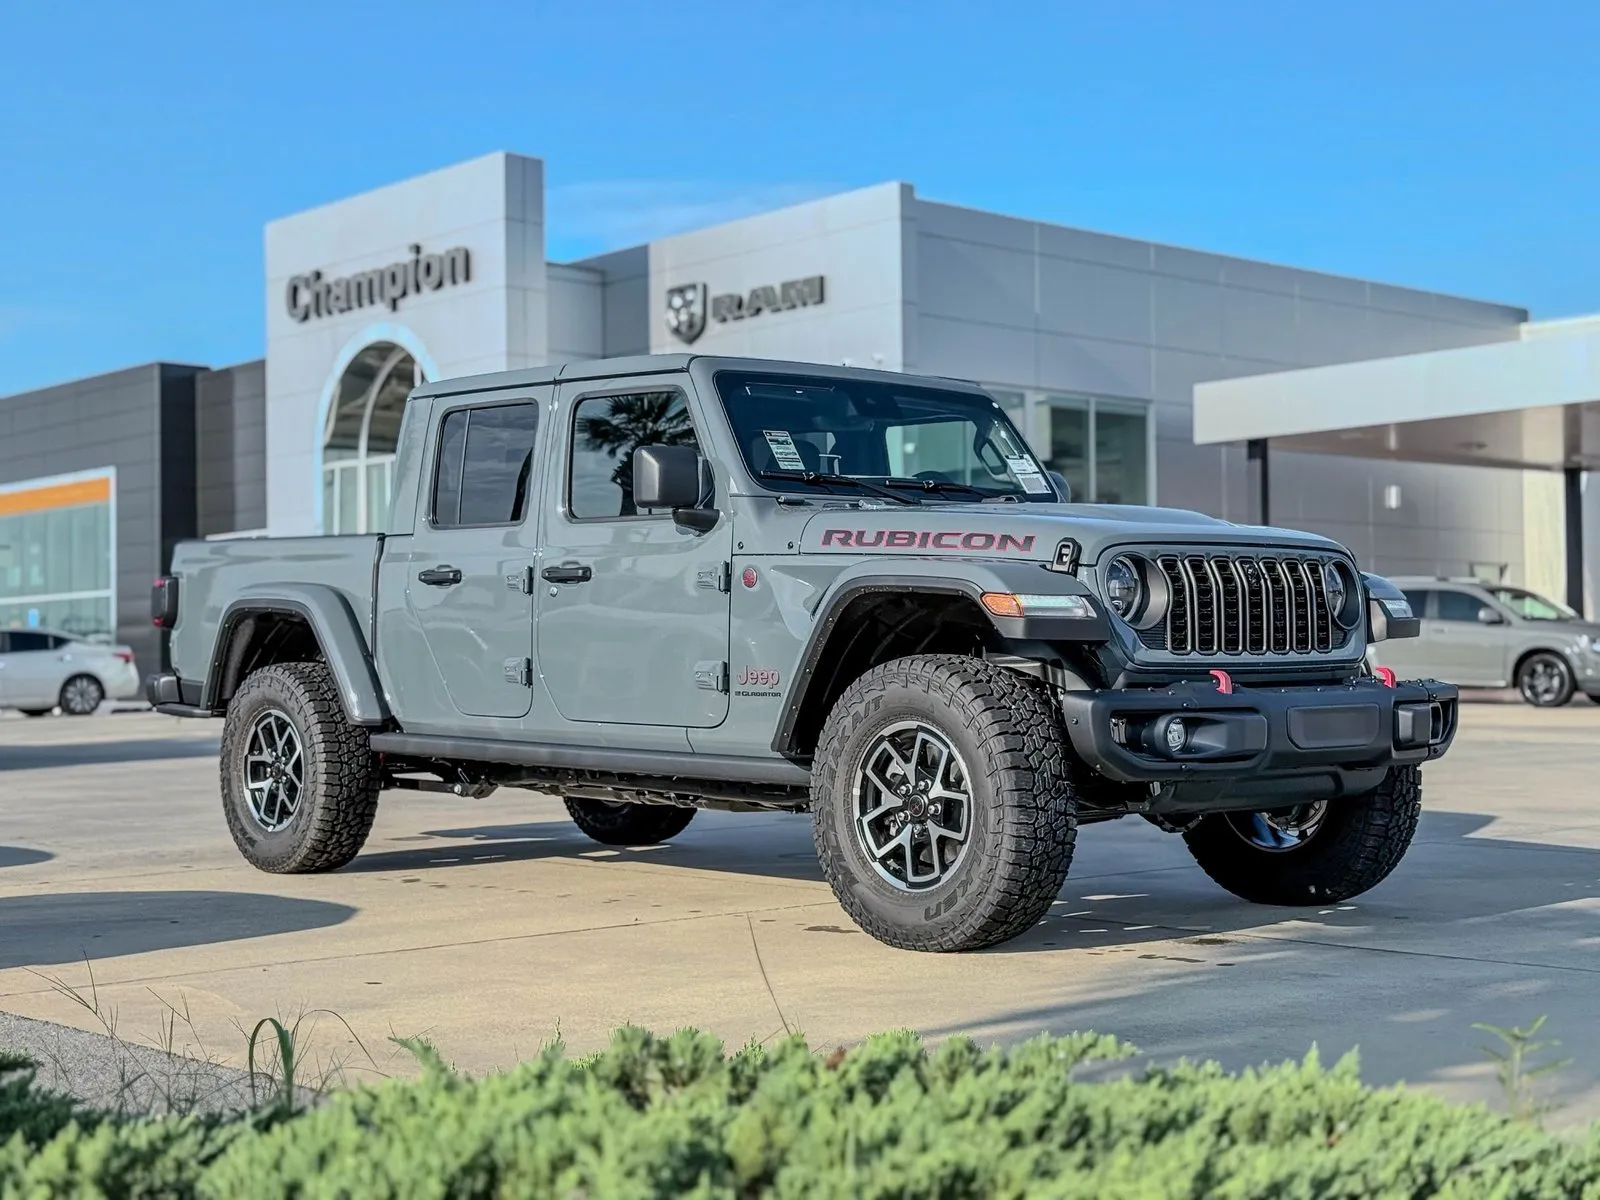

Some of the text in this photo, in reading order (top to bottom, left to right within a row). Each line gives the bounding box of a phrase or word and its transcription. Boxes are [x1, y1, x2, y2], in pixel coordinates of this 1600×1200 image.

[287, 243, 472, 323] Champion
[712, 275, 824, 323] RAM
[821, 528, 1036, 552] RUBICON
[736, 665, 780, 689] Jeep
